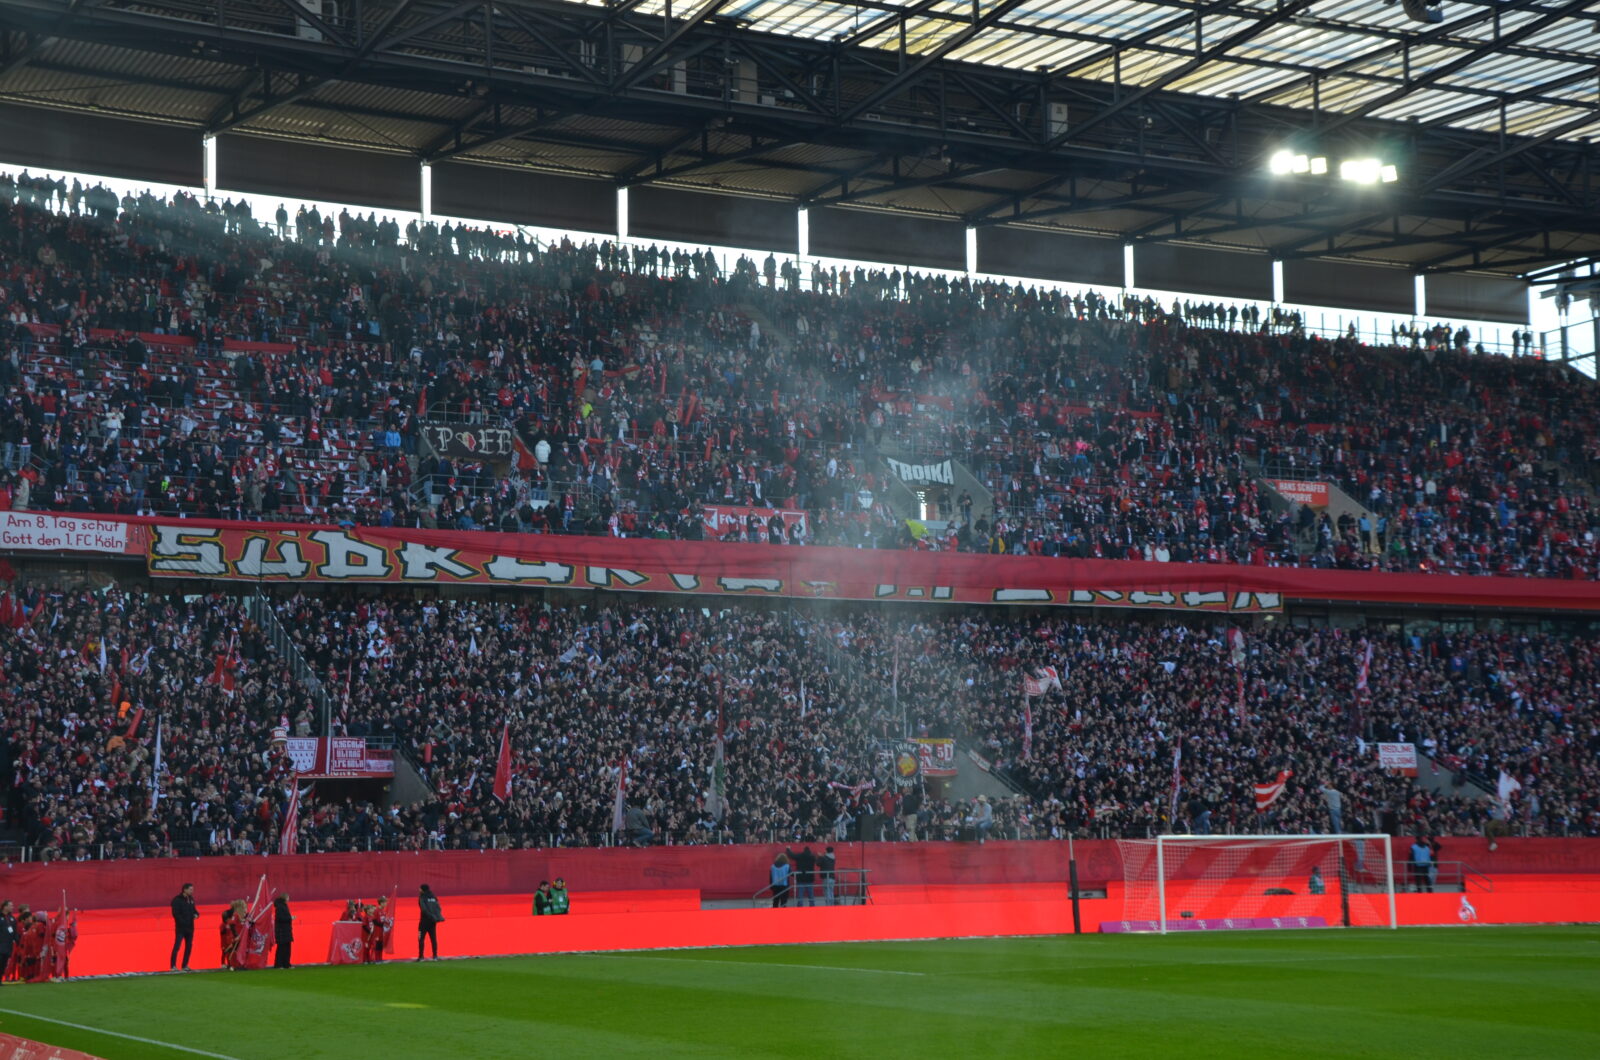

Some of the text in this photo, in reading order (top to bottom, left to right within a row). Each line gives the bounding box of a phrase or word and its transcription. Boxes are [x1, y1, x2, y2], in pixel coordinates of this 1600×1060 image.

[887, 457, 954, 485] TROIKA
[1279, 482, 1326, 492] HANS SCHÄFER
[7, 514, 119, 532] Am 8. Tag schuf
[2, 531, 32, 545] Gott
[37, 533, 60, 546] den
[65, 533, 73, 545] 1.
[76, 534, 92, 546] FC
[95, 534, 123, 549] Köln
